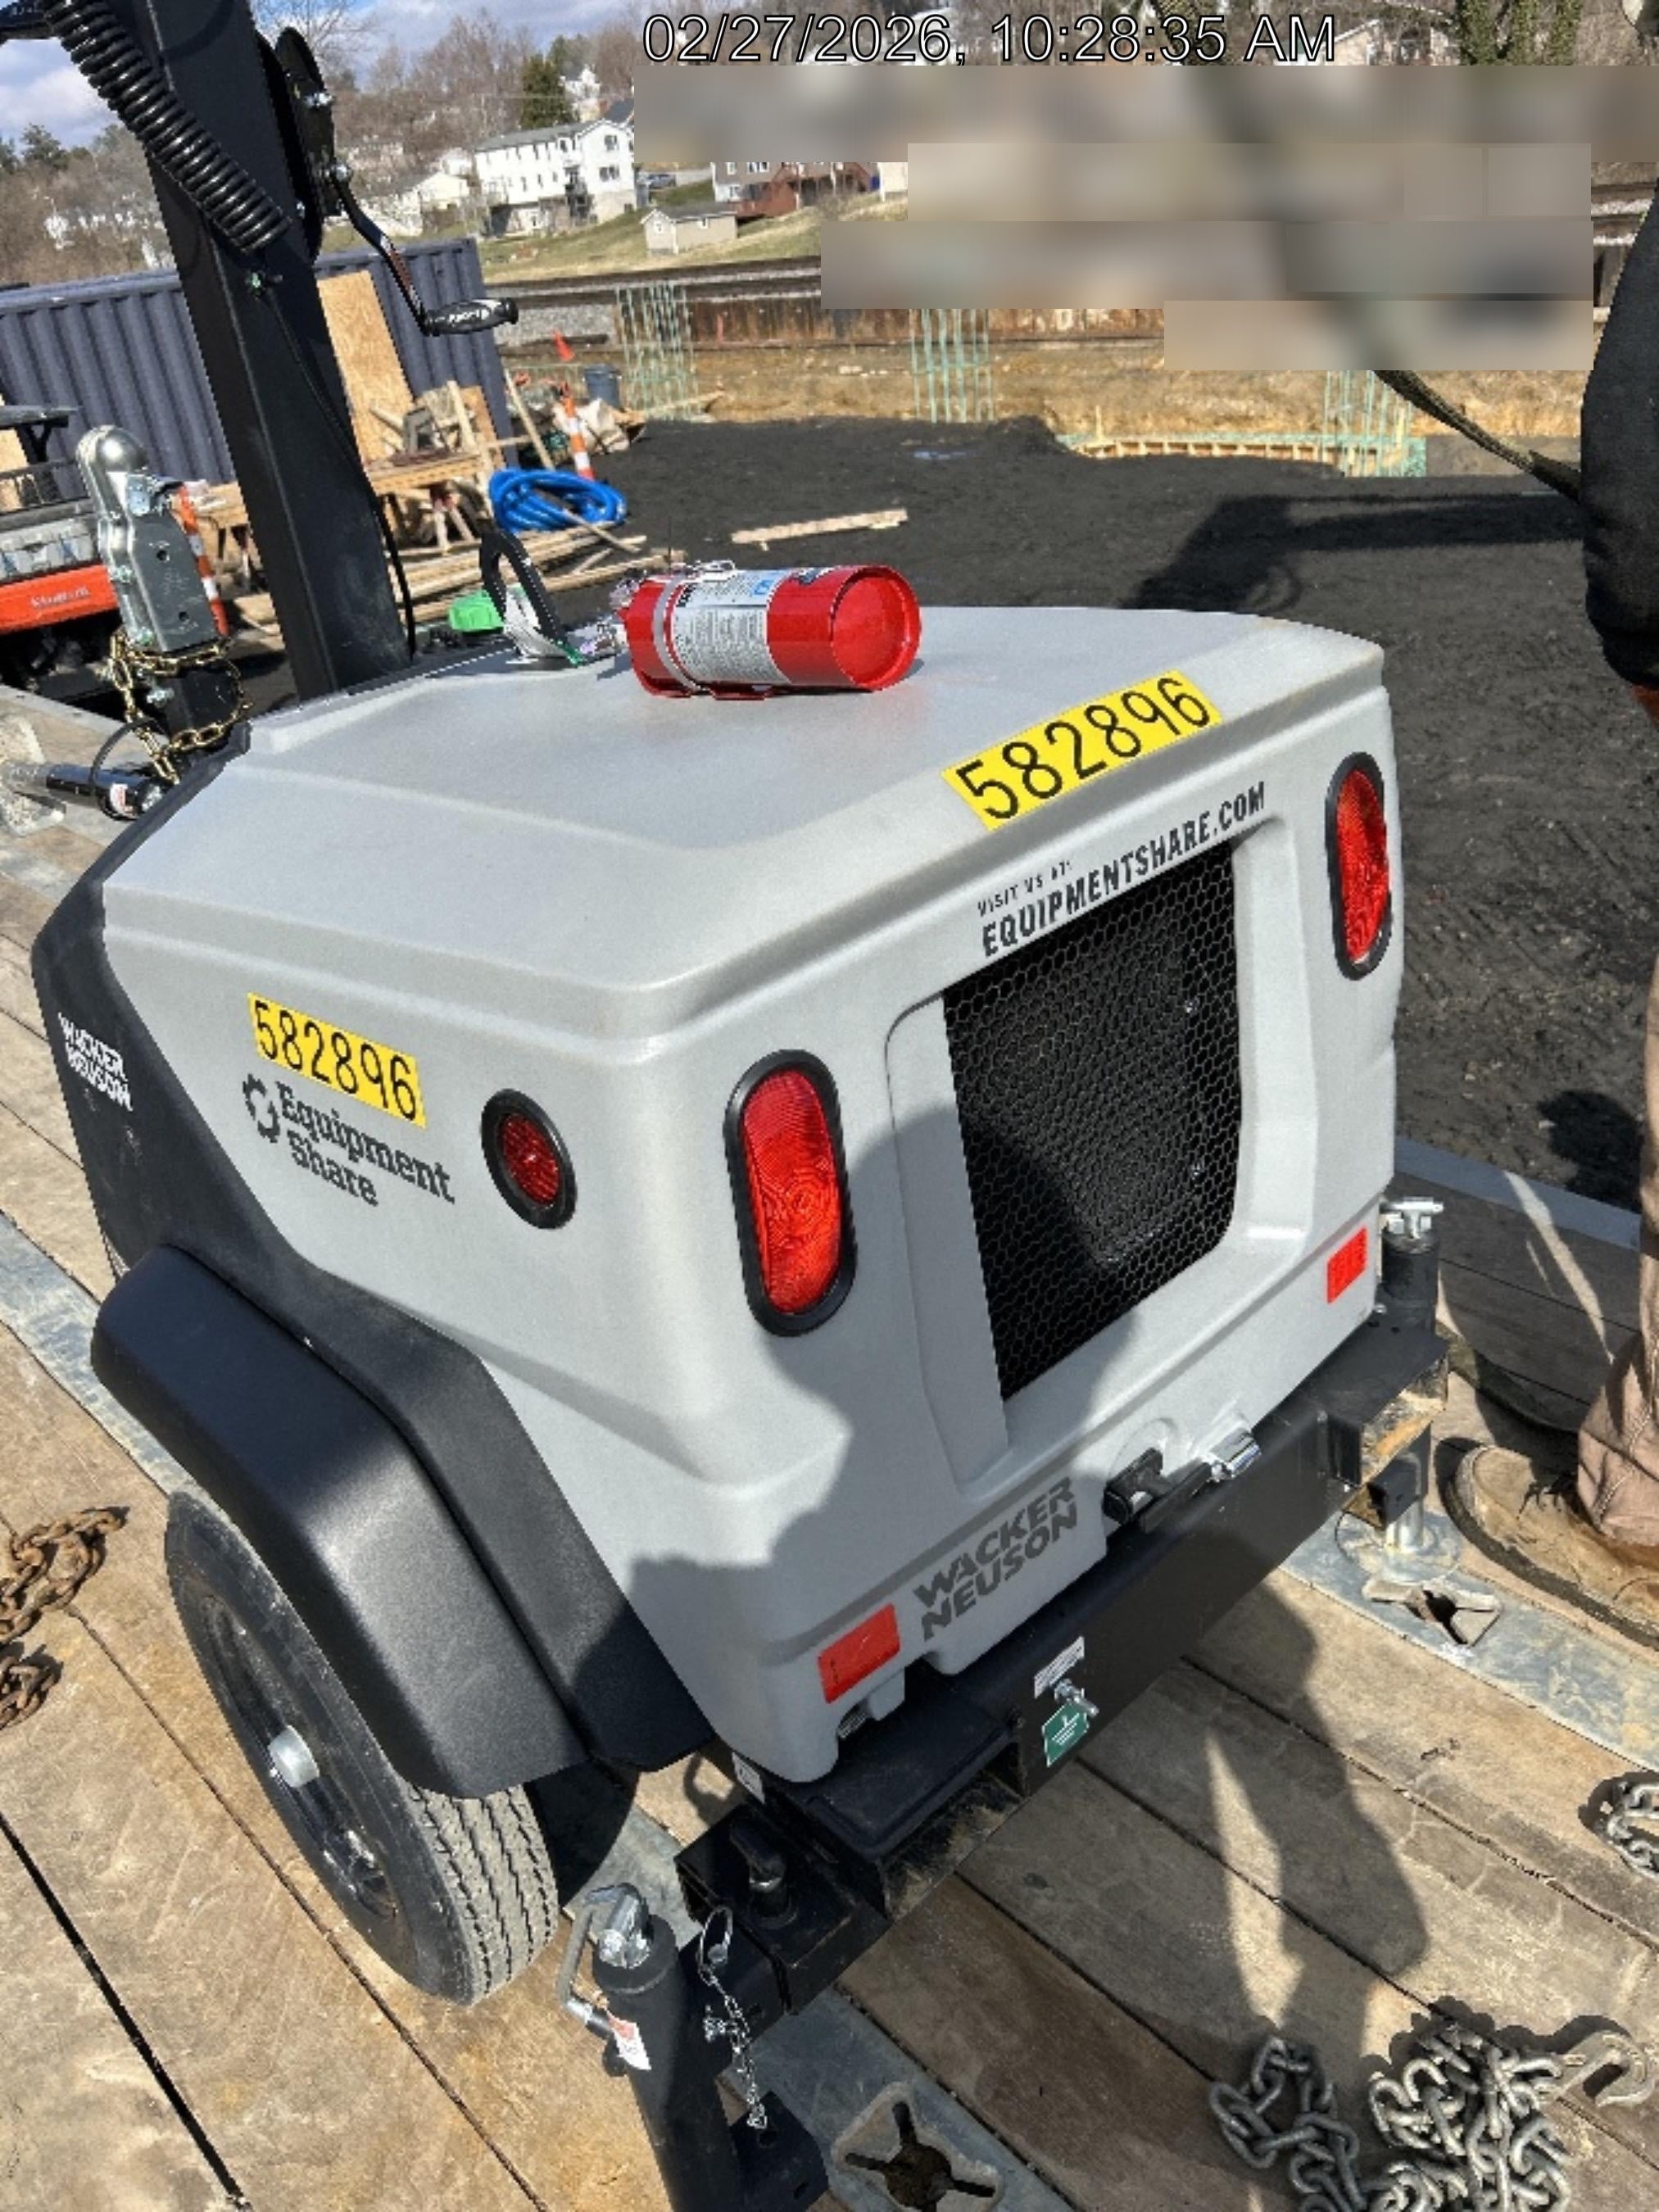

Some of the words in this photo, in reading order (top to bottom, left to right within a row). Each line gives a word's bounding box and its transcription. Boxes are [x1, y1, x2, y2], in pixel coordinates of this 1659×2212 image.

[955, 677, 1211, 819] 582896
[977, 884, 1018, 917] VISIT
[982, 781, 1265, 957] EQUIPMENTSHARE.COM
[254, 999, 416, 1122] 582896
[275, 1080, 456, 1205] Equipment
[287, 1129, 378, 1208] Share
[913, 1476, 1075, 1609] WACKER
[922, 1501, 1077, 1642] NEUSON
